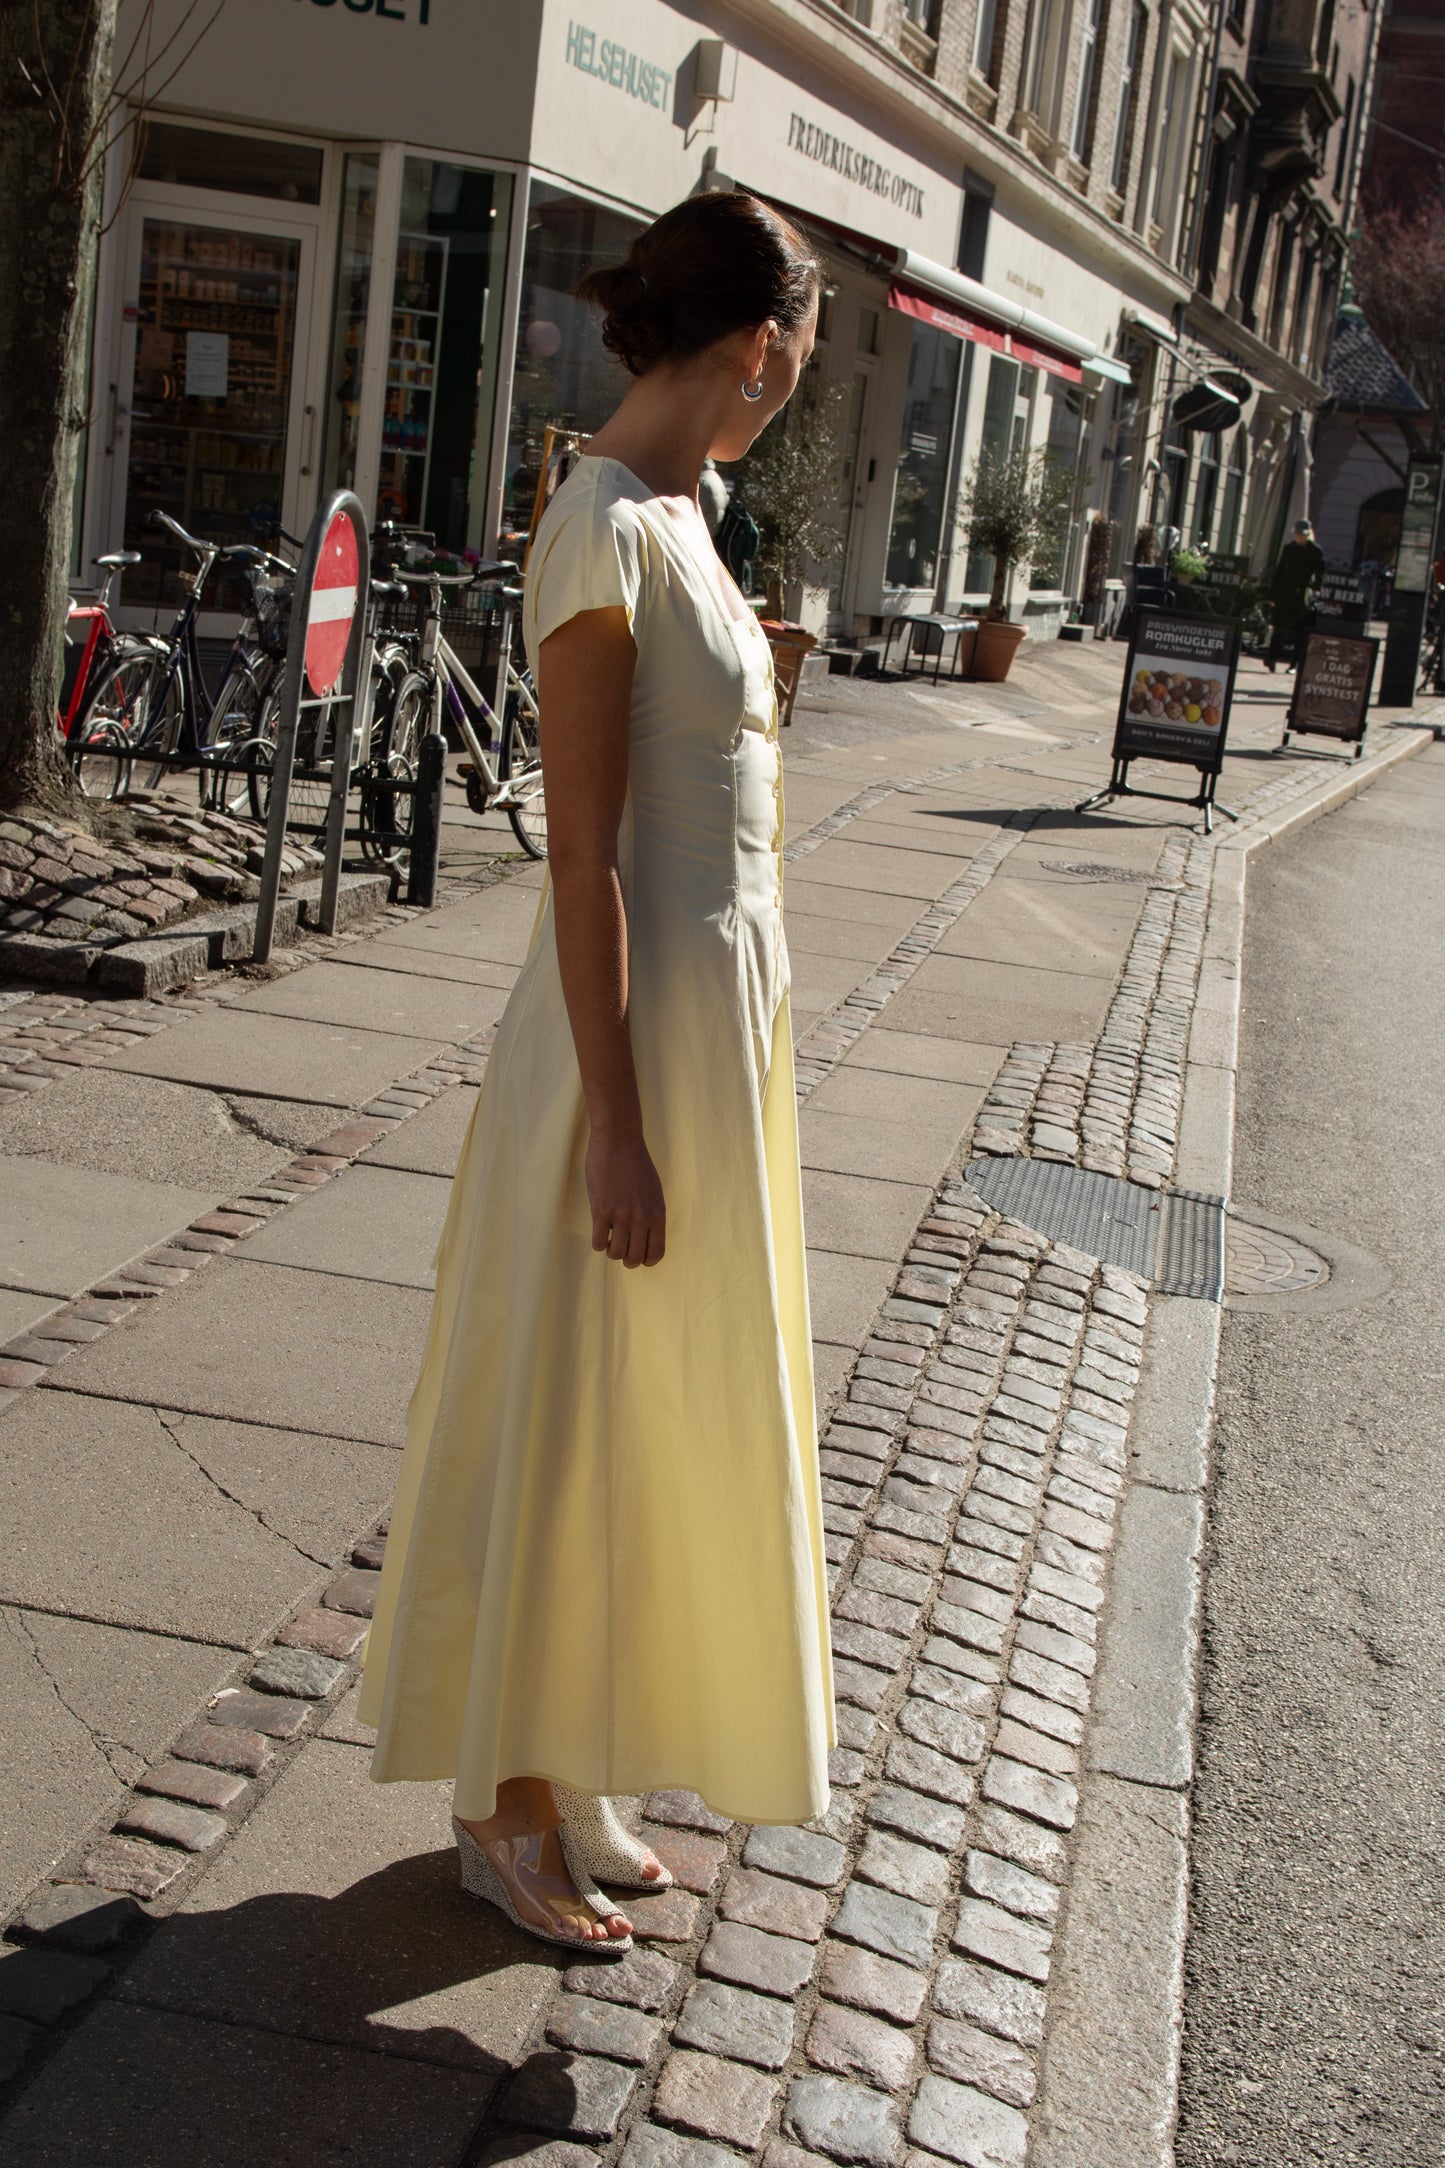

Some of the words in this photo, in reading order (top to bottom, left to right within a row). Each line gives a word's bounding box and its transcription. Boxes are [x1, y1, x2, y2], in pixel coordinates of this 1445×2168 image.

[565, 19, 673, 113] HELSEHUSET
[787, 112, 891, 198] FREDERIKSBERG
[891, 175, 925, 219] OPTIK
[1408, 471, 1430, 501] P
[1146, 620, 1226, 639] PRISVINDENDE
[1145, 630, 1225, 650] ROMKUGLER
[1328, 662, 1351, 675] DAG
[1315, 673, 1353, 688] GRATIS
[1304, 683, 1360, 701] SYNSTEST
